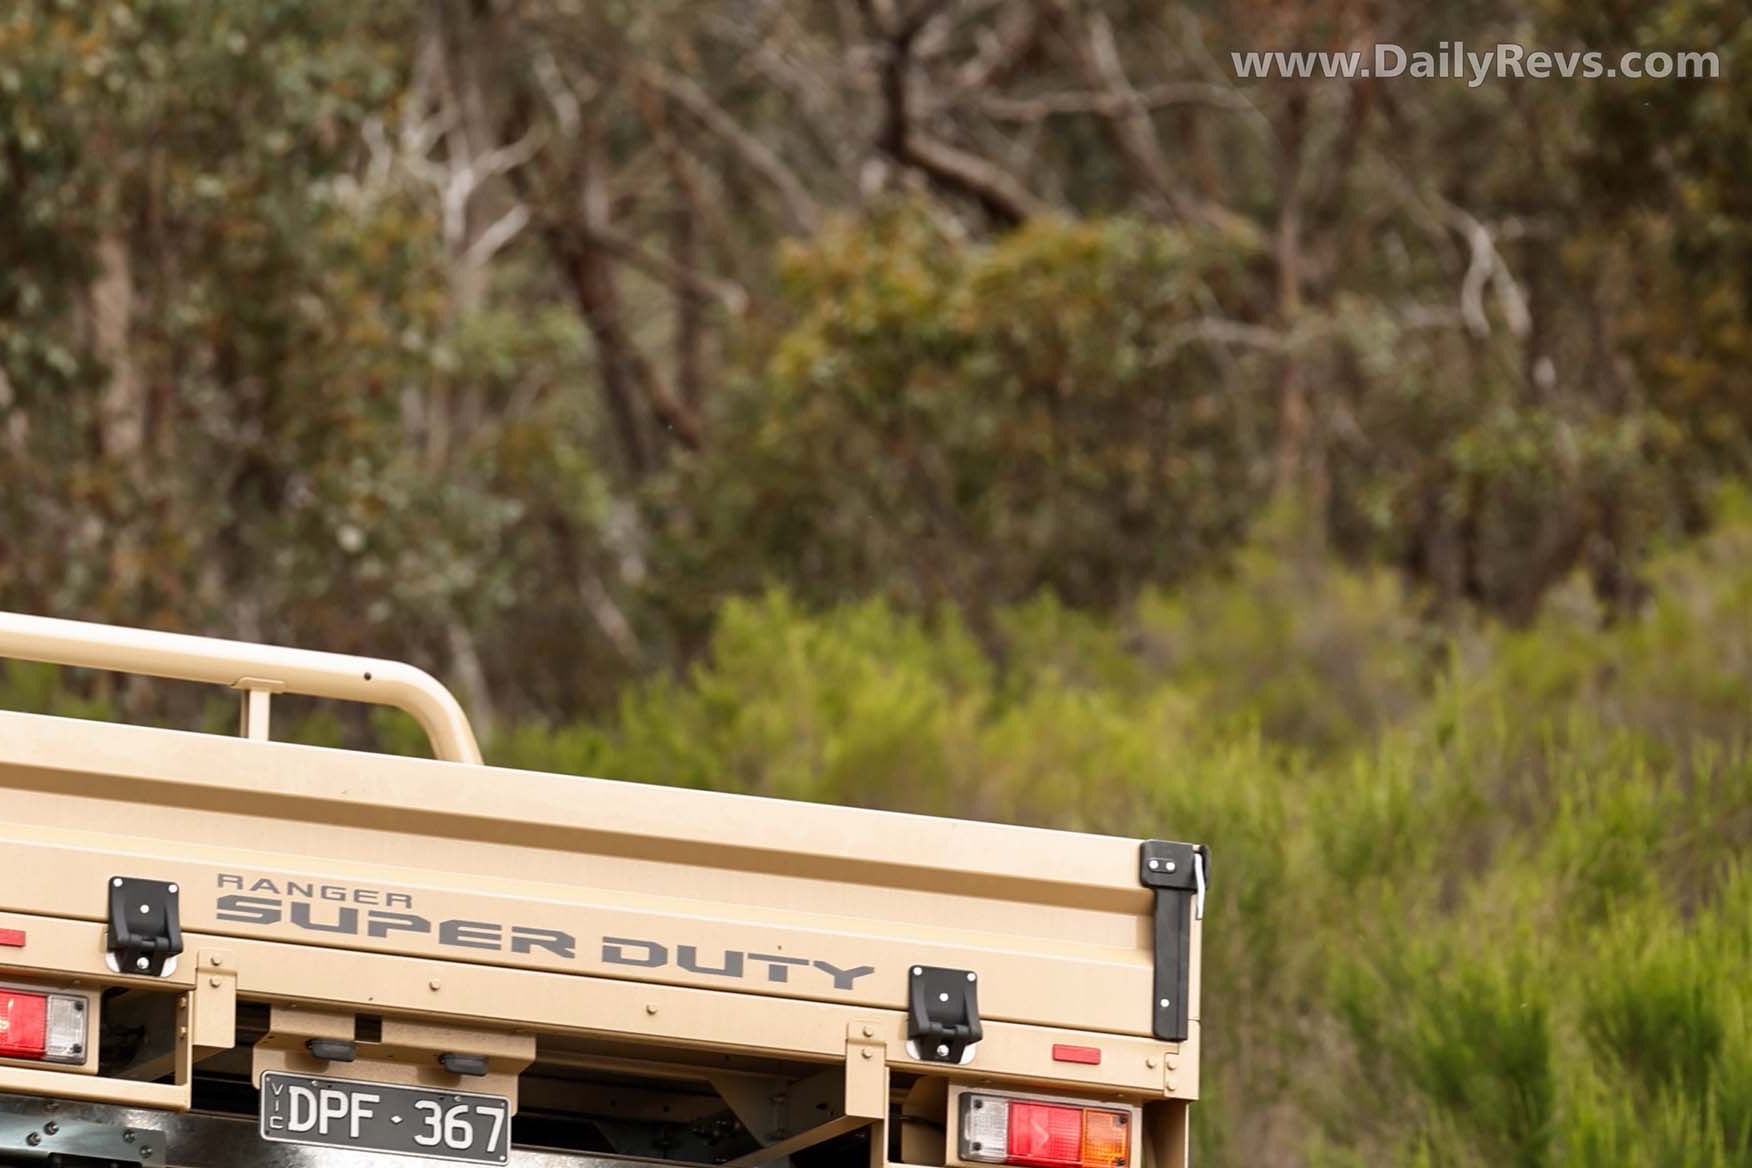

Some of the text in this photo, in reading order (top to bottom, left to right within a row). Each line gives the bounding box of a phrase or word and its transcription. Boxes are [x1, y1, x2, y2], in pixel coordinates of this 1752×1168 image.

[216, 872, 414, 910] RANGER
[215, 893, 876, 991] SUPER DUTY
[269, 1082, 284, 1130] VIC
[287, 1085, 505, 1153] DPF 367
